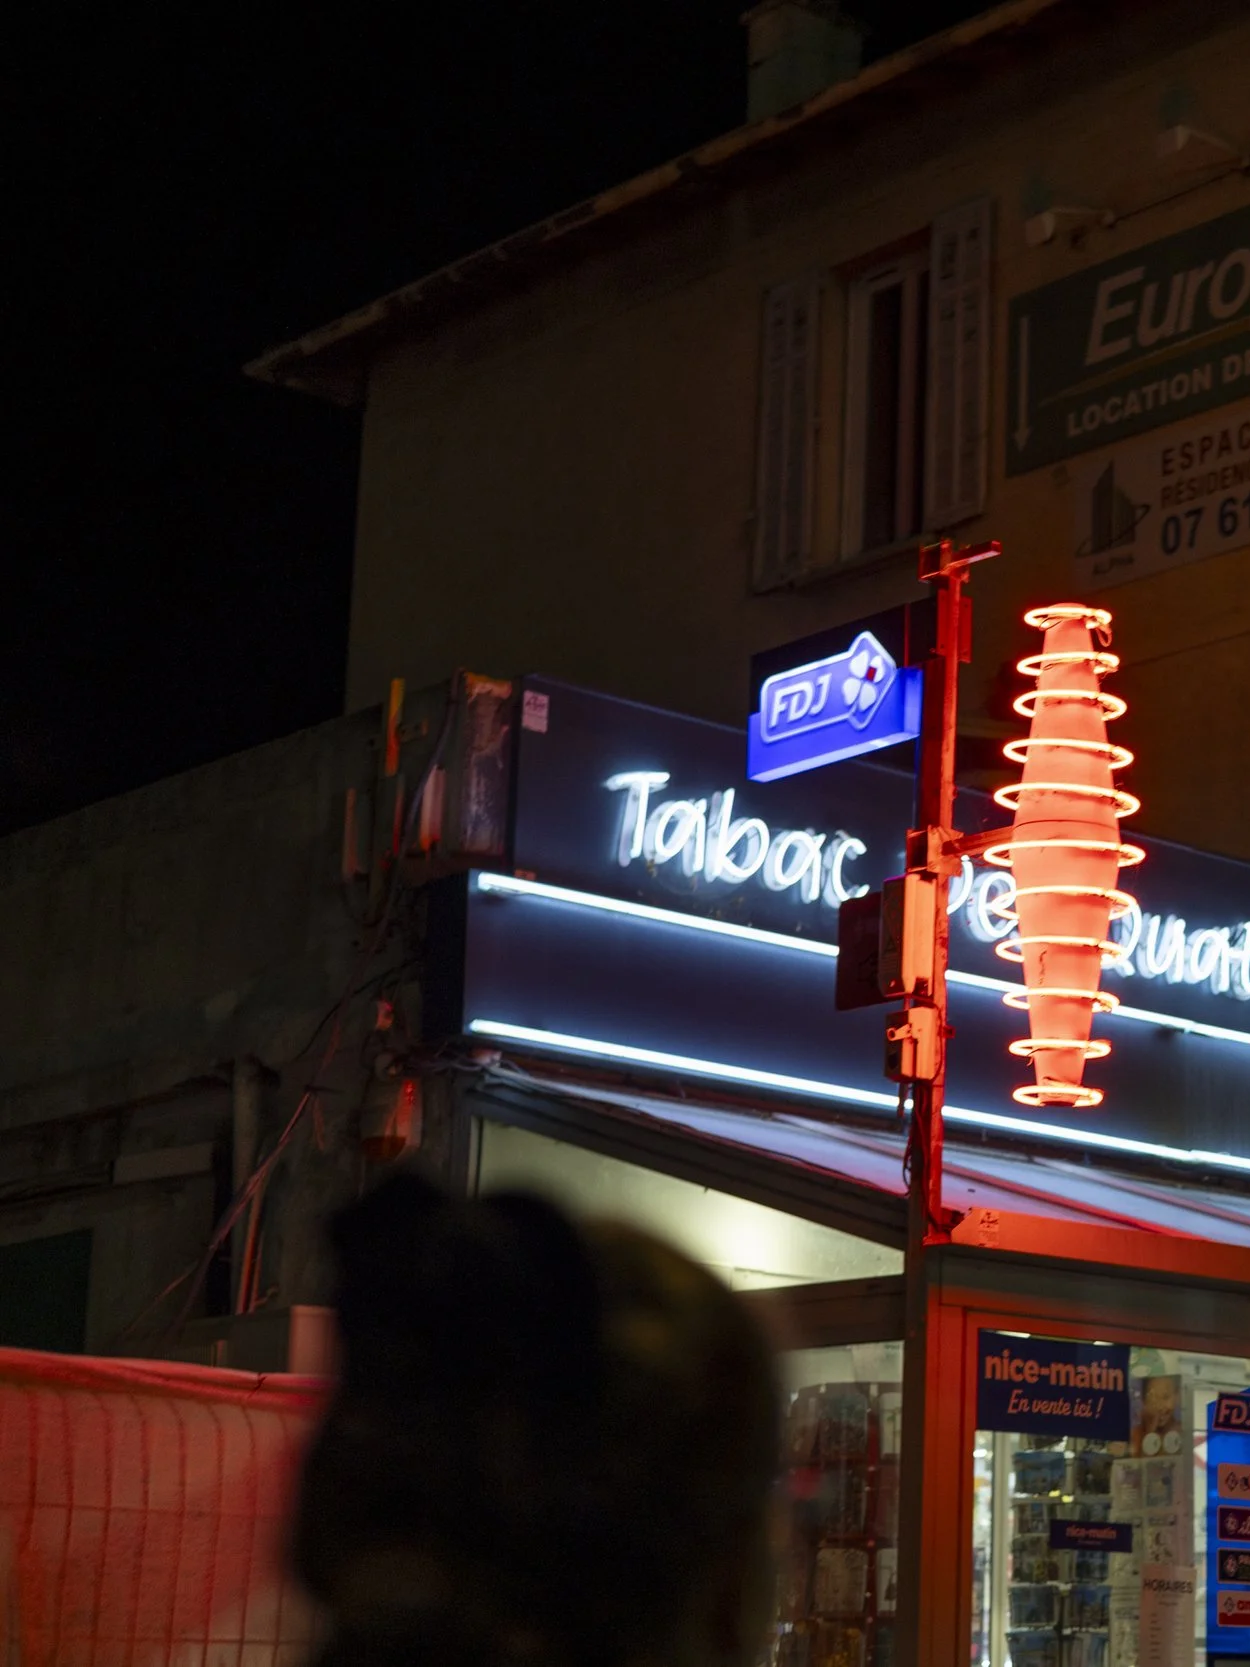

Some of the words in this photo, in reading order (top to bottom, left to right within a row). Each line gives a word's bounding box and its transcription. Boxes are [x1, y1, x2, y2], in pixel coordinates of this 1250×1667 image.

[1066, 363, 1214, 439] LOCATION
[1161, 505, 1205, 556] 07
[768, 672, 832, 729] FDJ
[606, 770, 870, 907] Tabac
[984, 1348, 1125, 1393] nice-matin
[1007, 1388, 1030, 1416] En
[1031, 1397, 1072, 1417] vente
[1073, 1398, 1094, 1418] ici
